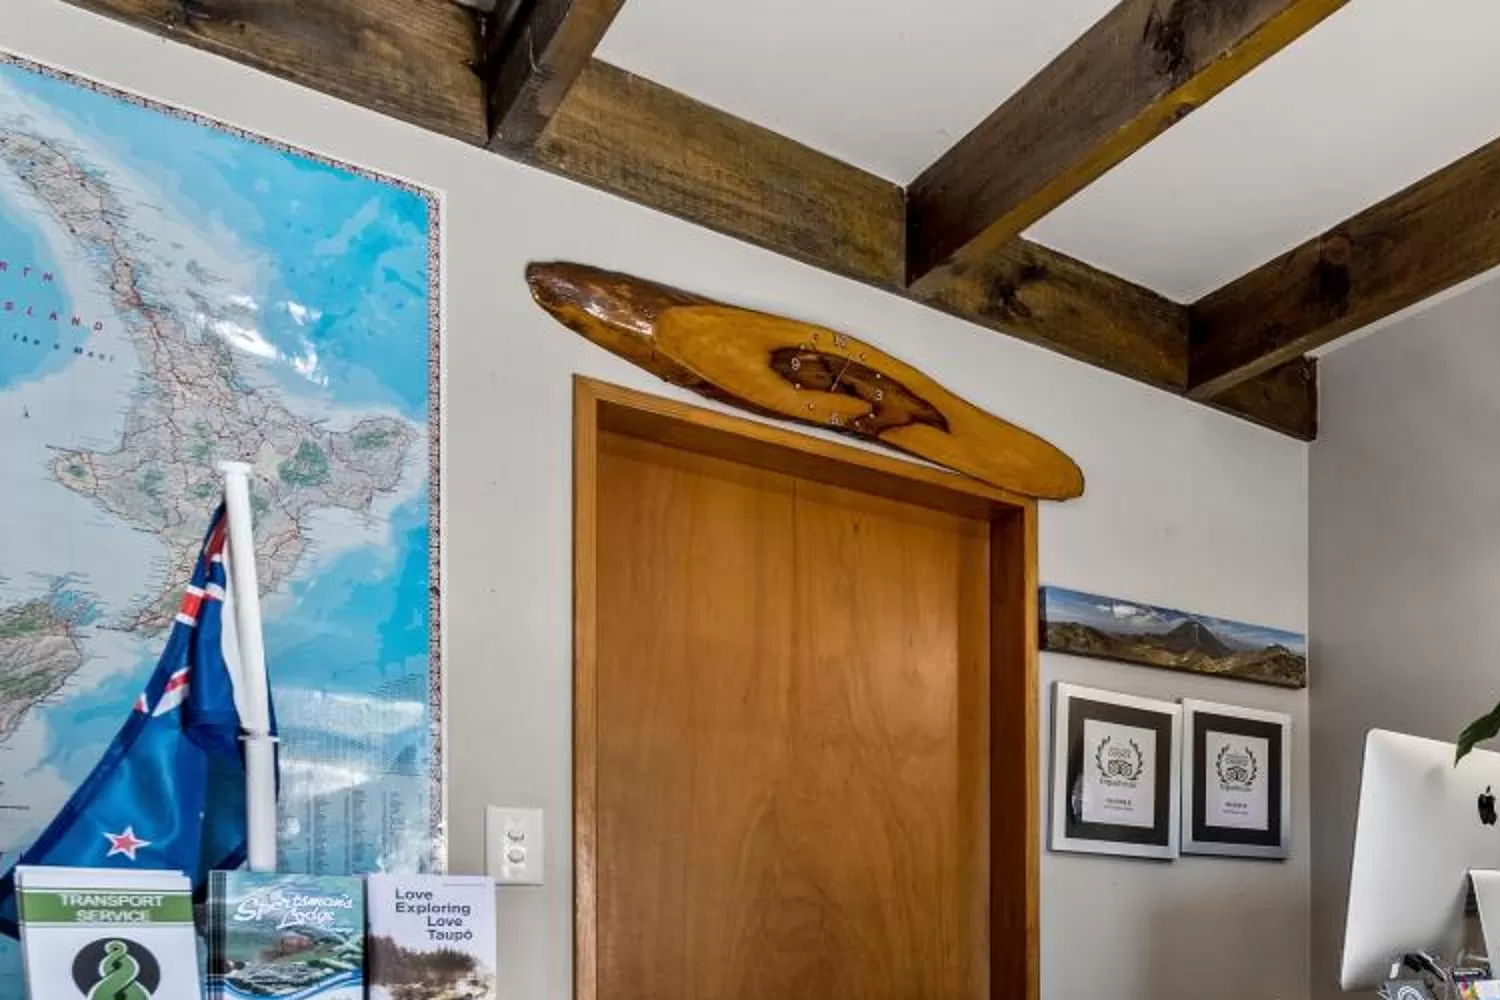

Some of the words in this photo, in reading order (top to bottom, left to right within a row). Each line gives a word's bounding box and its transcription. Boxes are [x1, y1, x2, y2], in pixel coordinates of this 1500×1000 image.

[60, 893, 165, 908] TRANSPORT
[395, 888, 433, 900] Love
[75, 909, 150, 923] SERVICE
[395, 902, 471, 916] Exploring
[427, 916, 463, 927] Love
